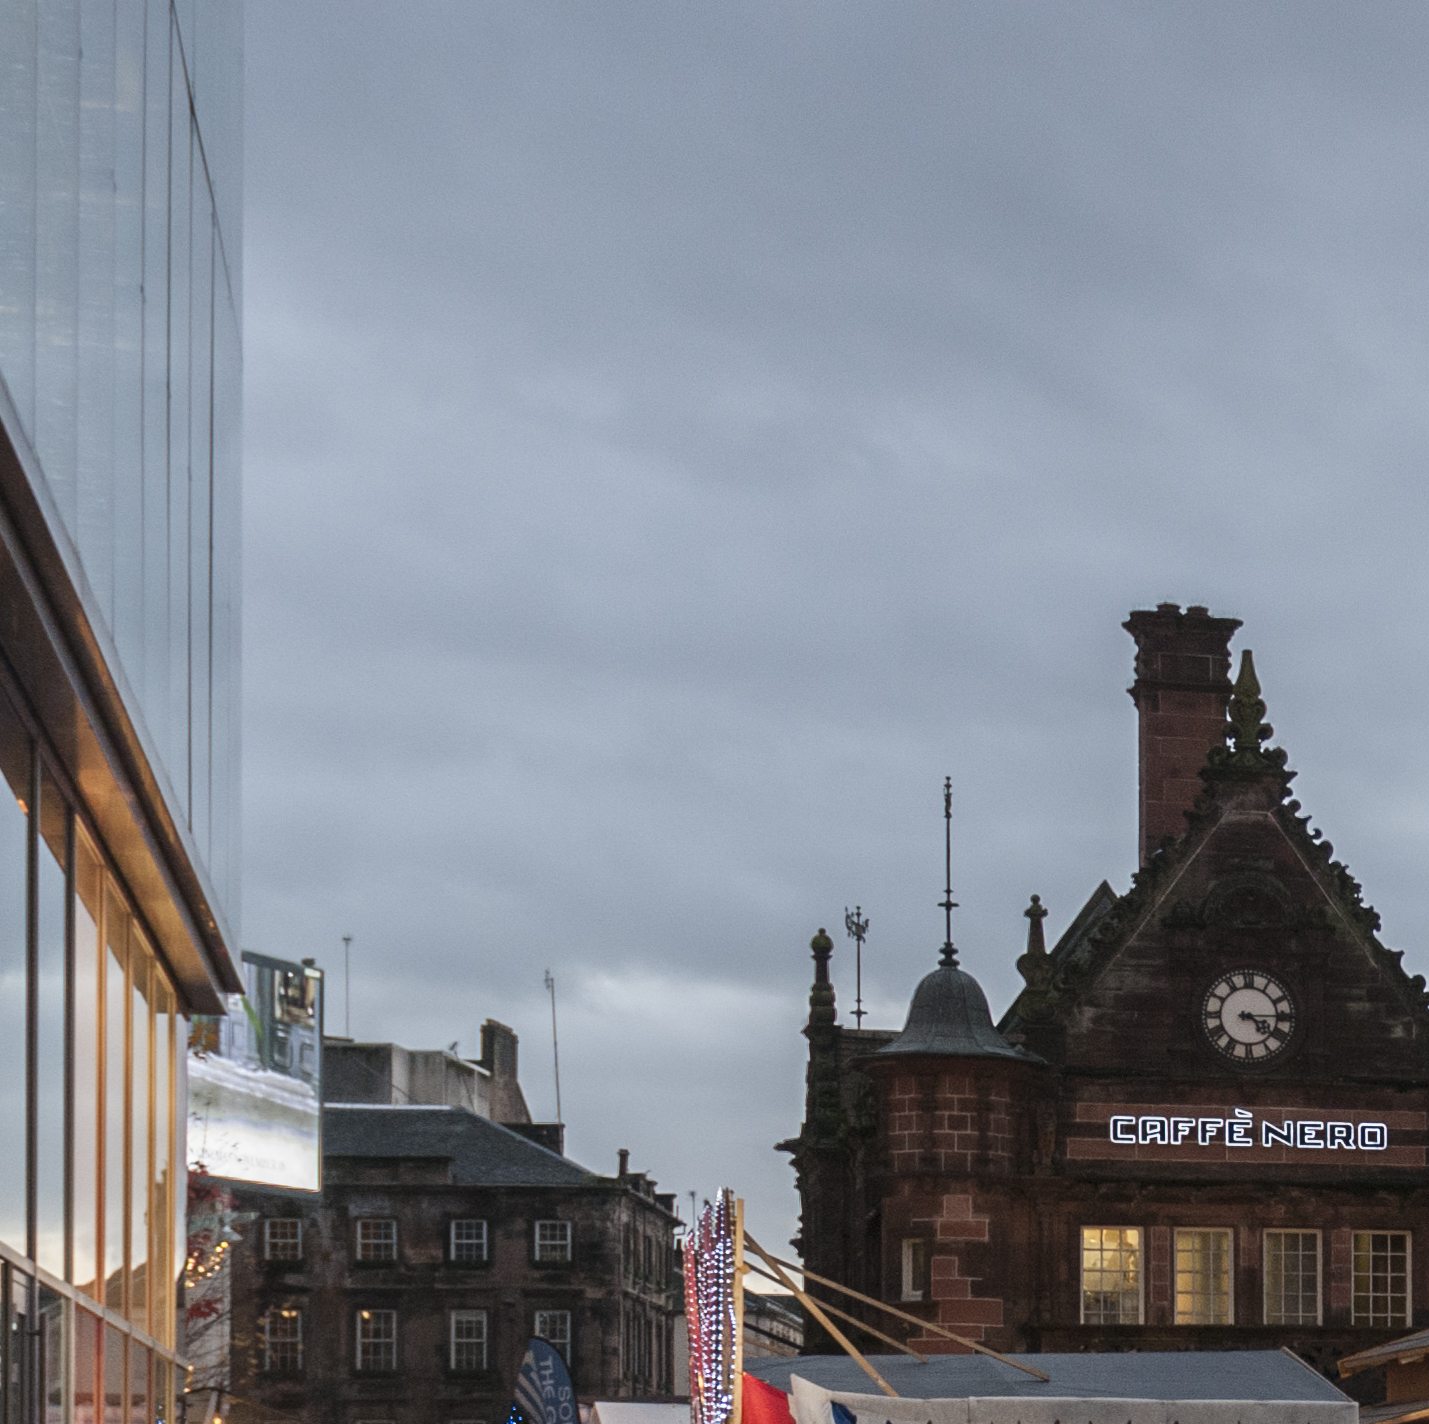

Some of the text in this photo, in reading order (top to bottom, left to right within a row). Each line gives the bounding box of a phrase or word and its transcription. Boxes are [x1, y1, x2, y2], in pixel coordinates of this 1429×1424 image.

[1109, 1108, 1388, 1150] CAFFÈ NERO
[540, 1356, 556, 1398] THE
